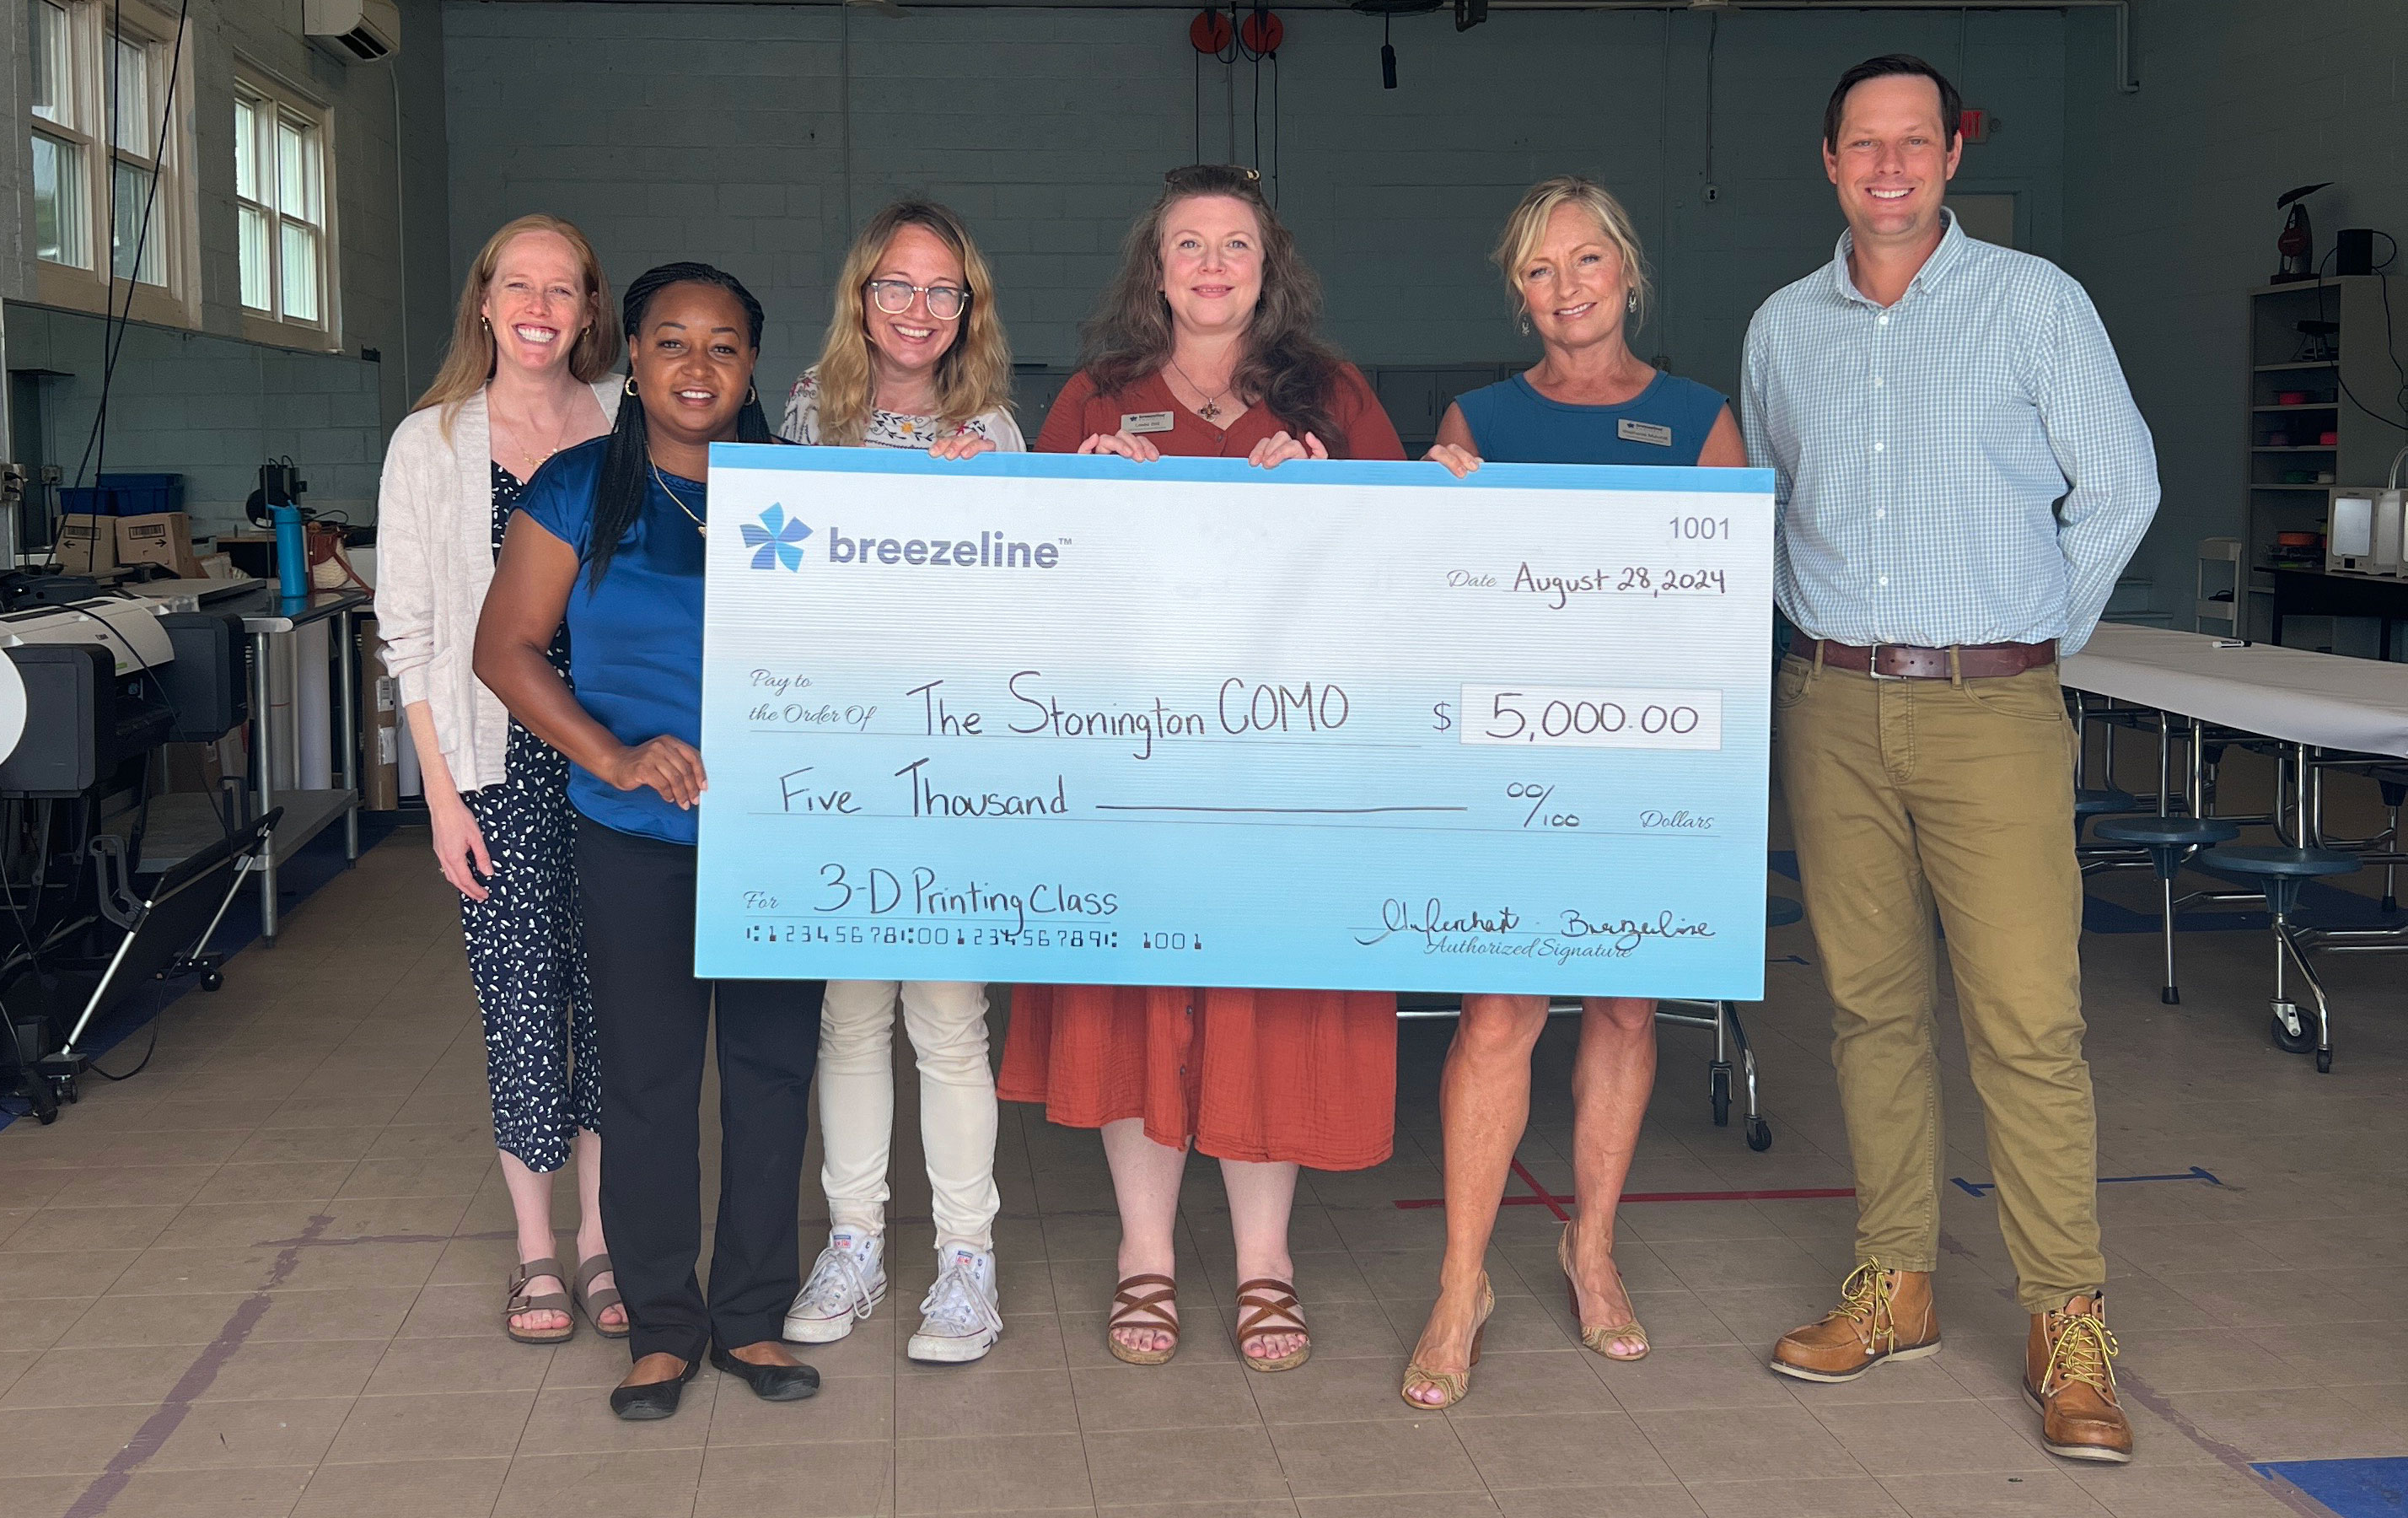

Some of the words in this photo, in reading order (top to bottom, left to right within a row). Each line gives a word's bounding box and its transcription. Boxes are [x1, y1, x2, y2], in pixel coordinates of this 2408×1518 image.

[1669, 516, 1729, 541] 1001
[1446, 569, 1498, 589] Date
[1512, 561, 1610, 611] August
[750, 668, 791, 695] Pay
[793, 673, 814, 689] to
[748, 702, 780, 723] the
[782, 702, 841, 726] Order
[844, 703, 879, 732] Of
[906, 679, 984, 738] The
[1007, 670, 1206, 761] Stonington
[1218, 676, 1350, 735] COMO
[1432, 700, 1453, 735] $
[1485, 691, 1700, 743] 5,000.00
[779, 766, 863, 815] Five
[894, 756, 1070, 819] Thousand
[1639, 809, 1716, 831] Dollars
[743, 890, 781, 911] For
[812, 862, 902, 918] 3-D
[912, 866, 1024, 938] Printing
[1028, 882, 1120, 917] Class
[1142, 931, 1203, 951] 1001
[1422, 934, 1538, 959] Authorized
[1538, 937, 1633, 966] Signature
